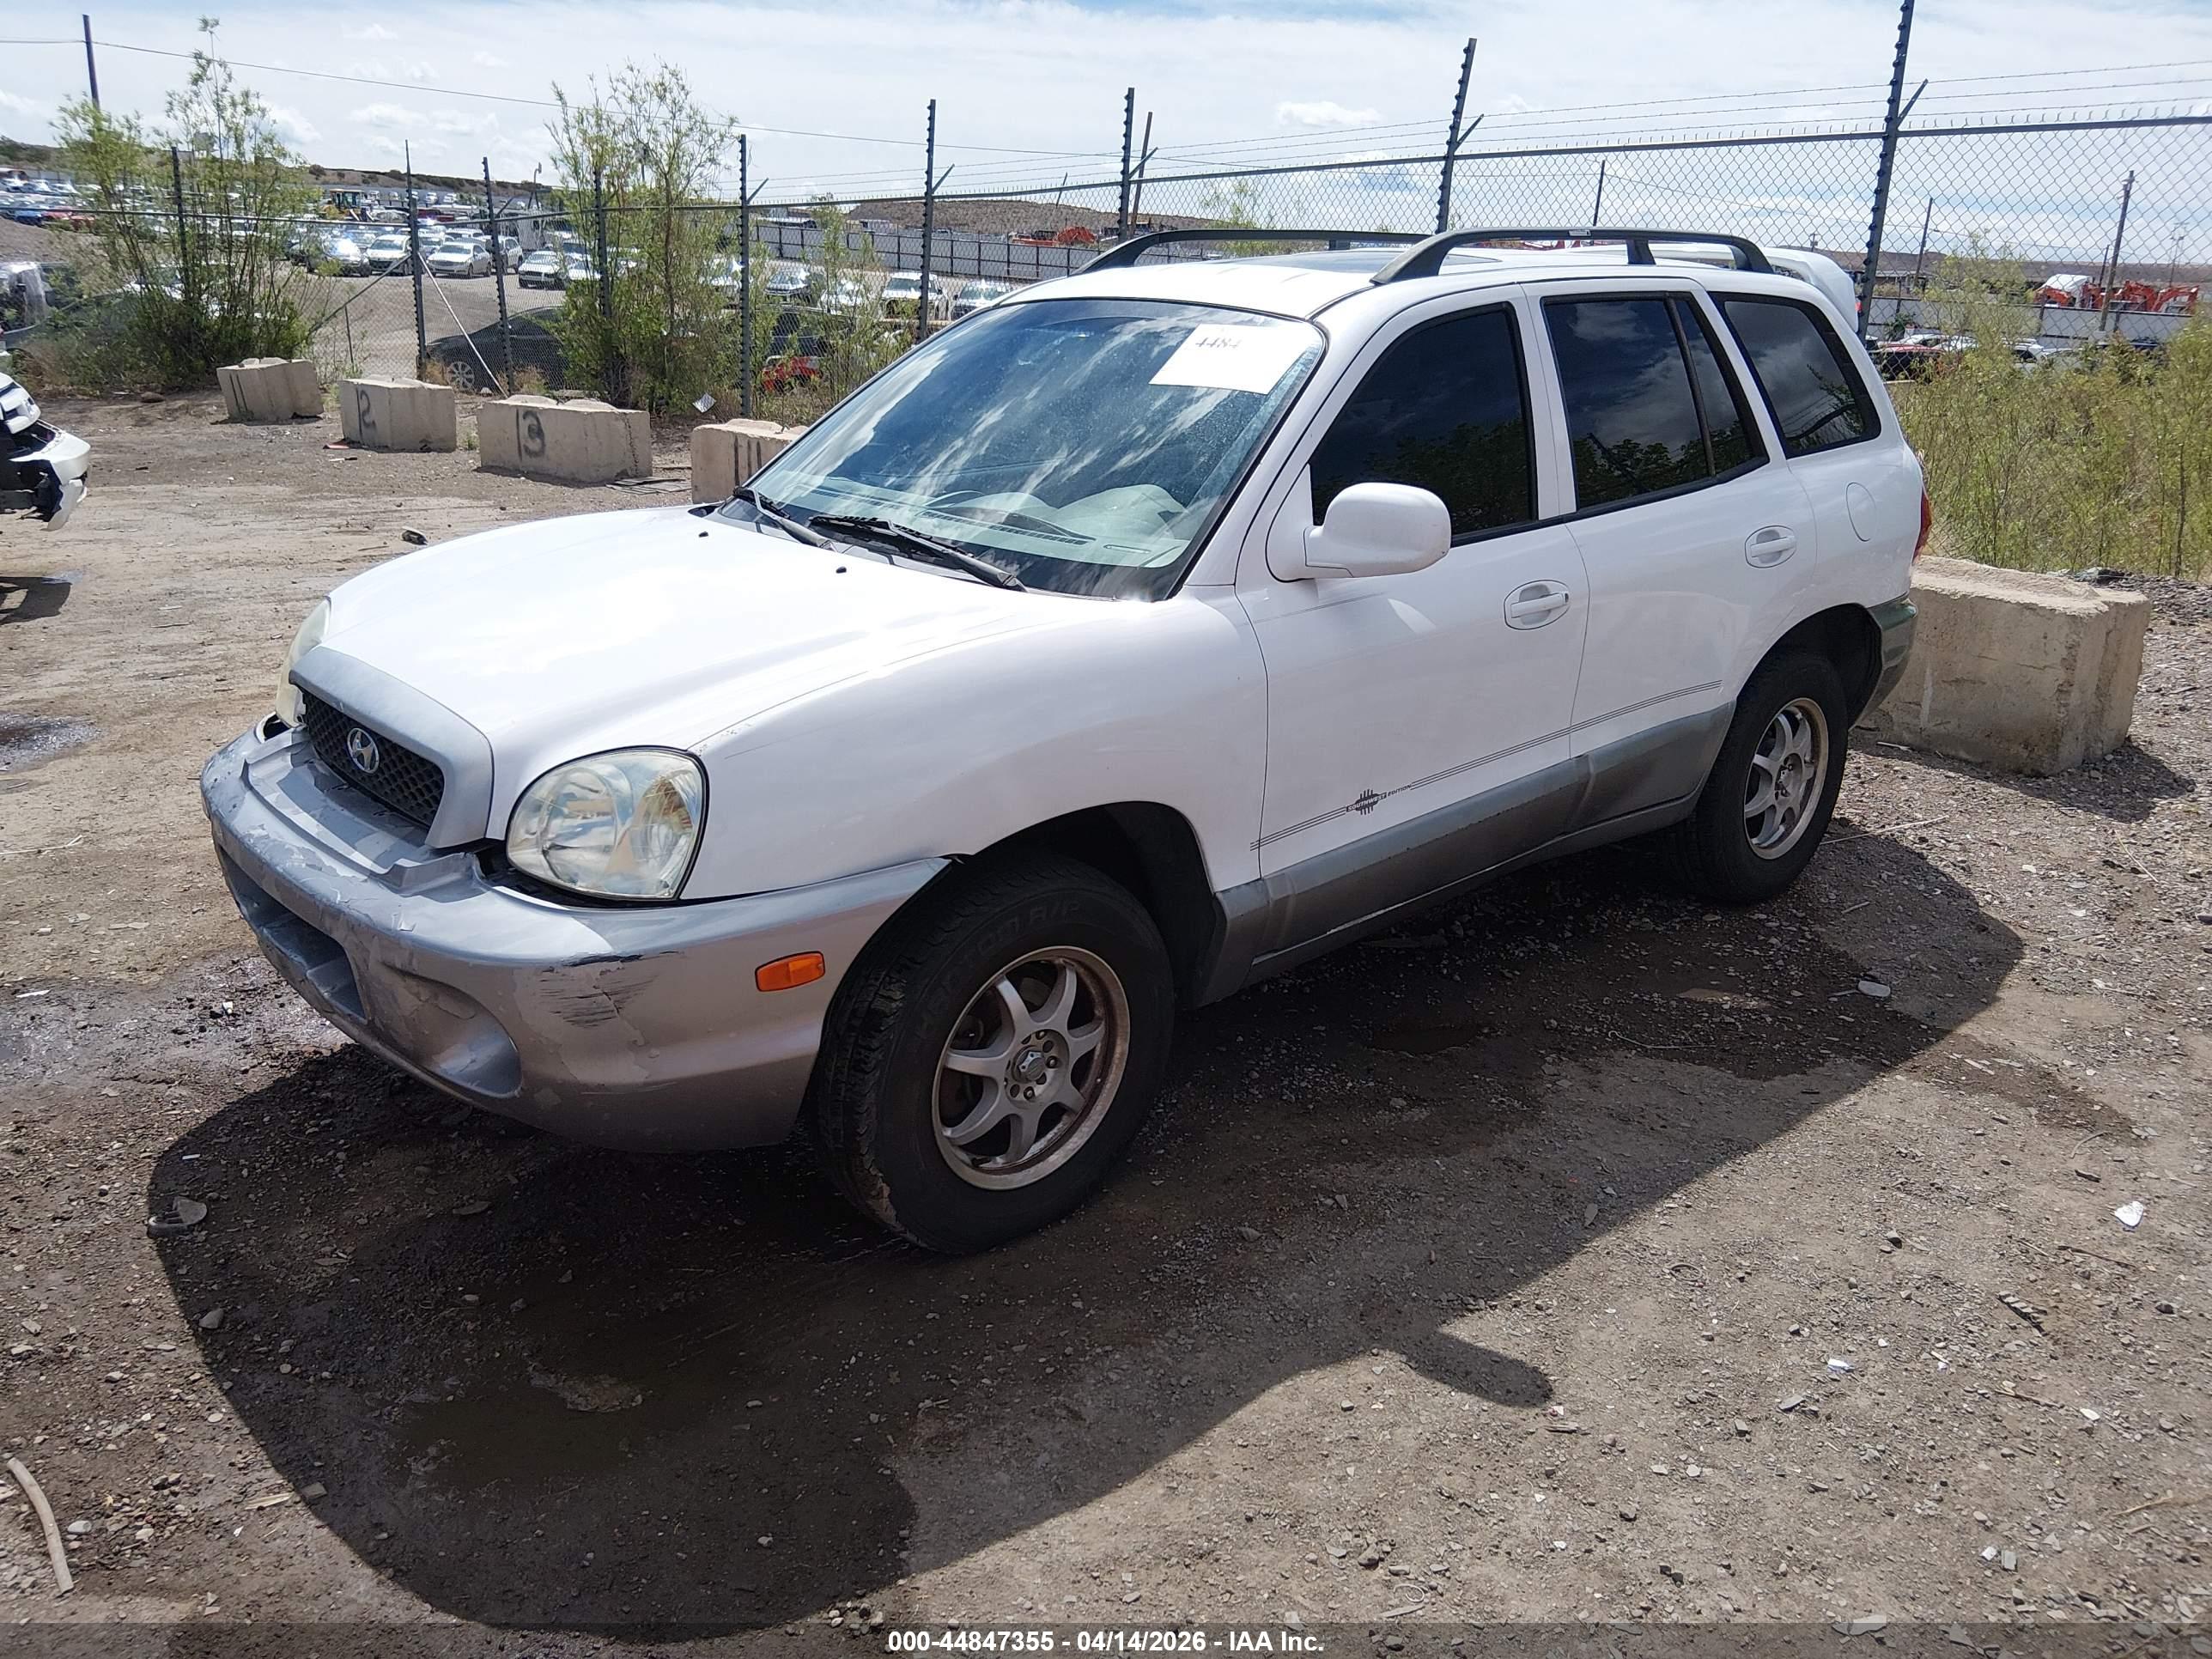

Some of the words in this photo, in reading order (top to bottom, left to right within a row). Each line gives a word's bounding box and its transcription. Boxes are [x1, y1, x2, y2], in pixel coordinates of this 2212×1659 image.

[356, 386, 377, 441] 12
[516, 408, 547, 462] 13
[1347, 792, 1387, 811] SOUTHWEST
[1388, 784, 1412, 796] EDITION
